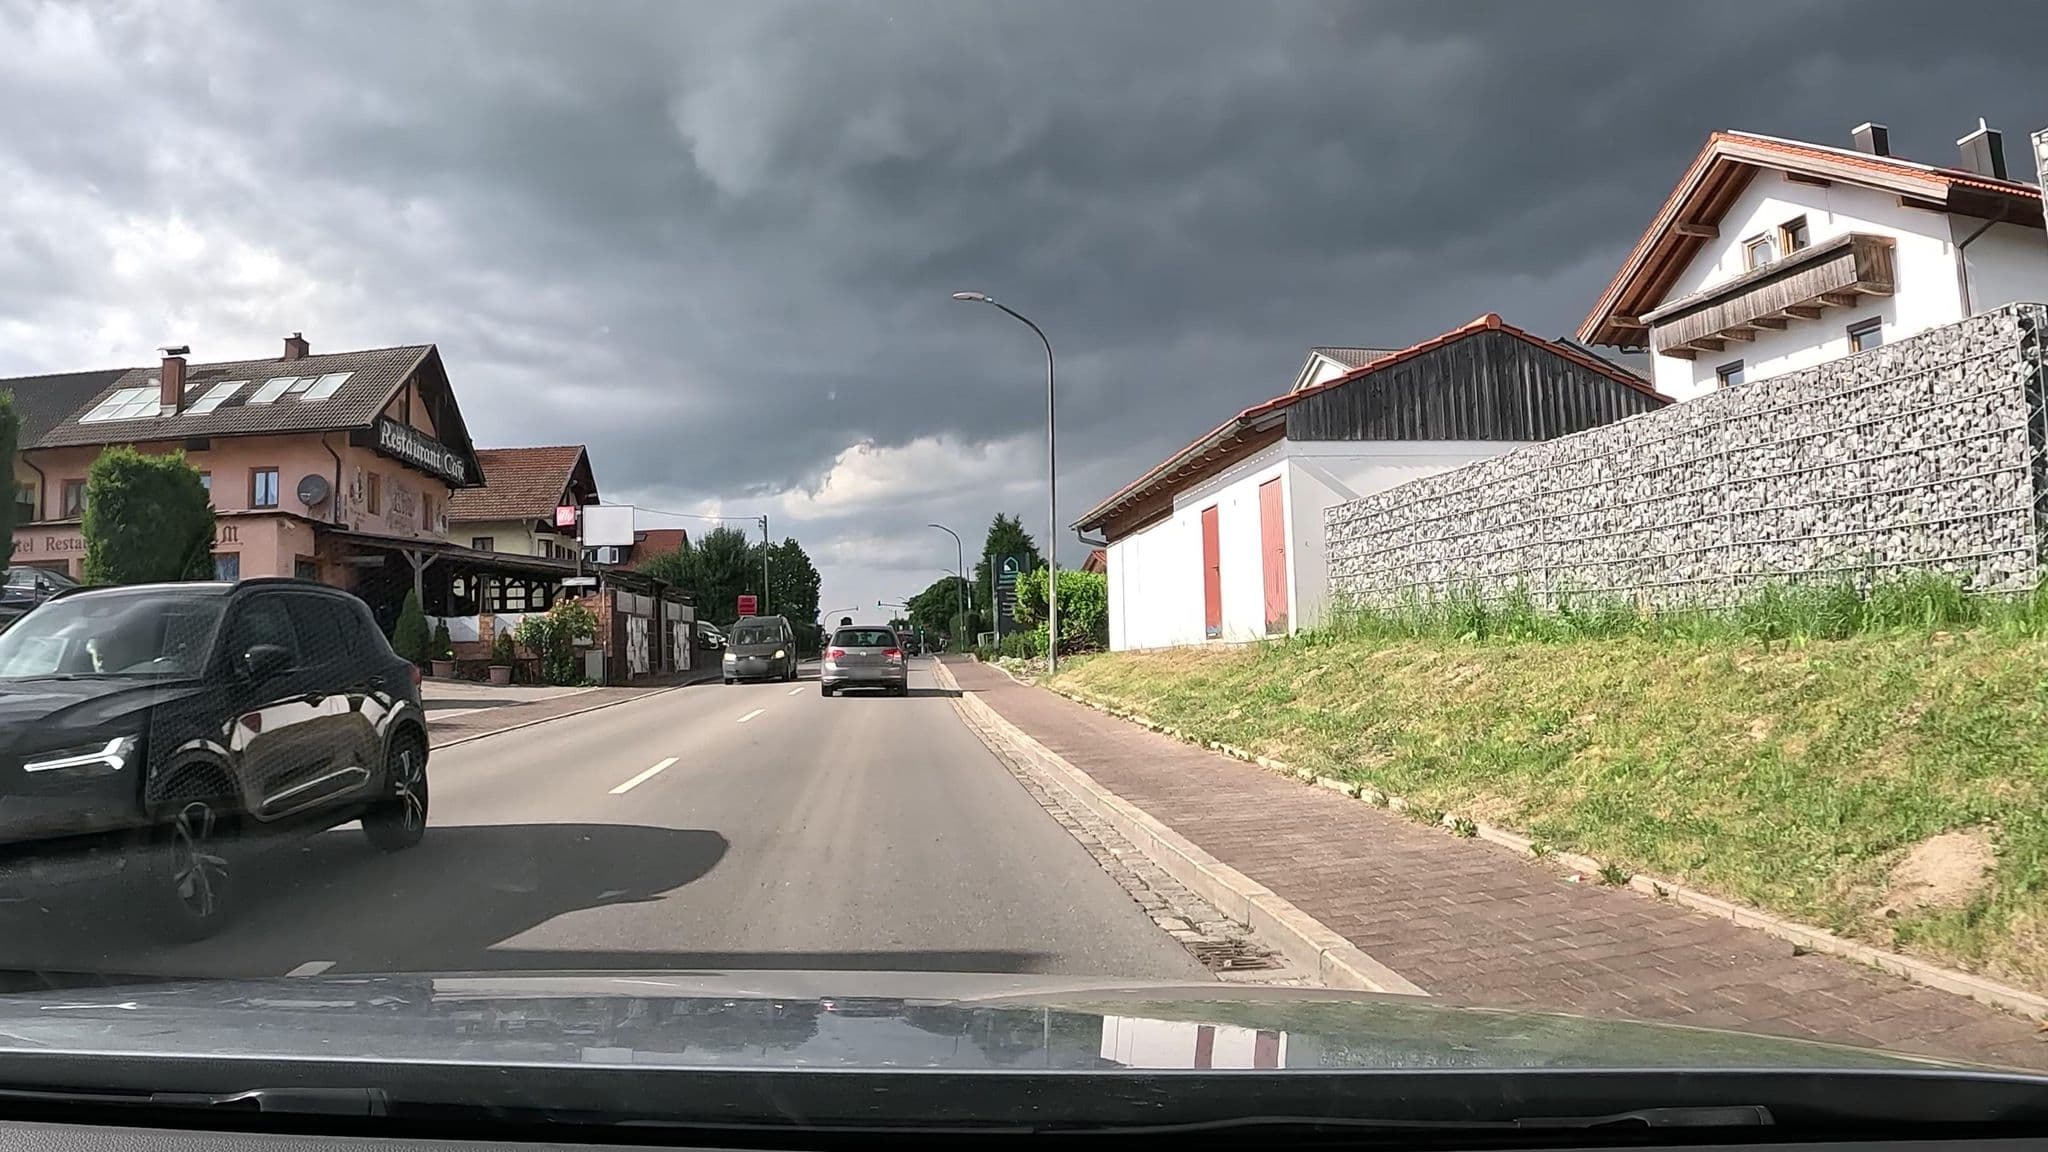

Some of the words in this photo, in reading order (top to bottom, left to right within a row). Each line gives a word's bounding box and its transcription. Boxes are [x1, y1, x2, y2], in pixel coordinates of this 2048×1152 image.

[380, 420, 441, 469] Restaurant
[16, 537, 34, 553] tel
[46, 536, 87, 552] Resta
